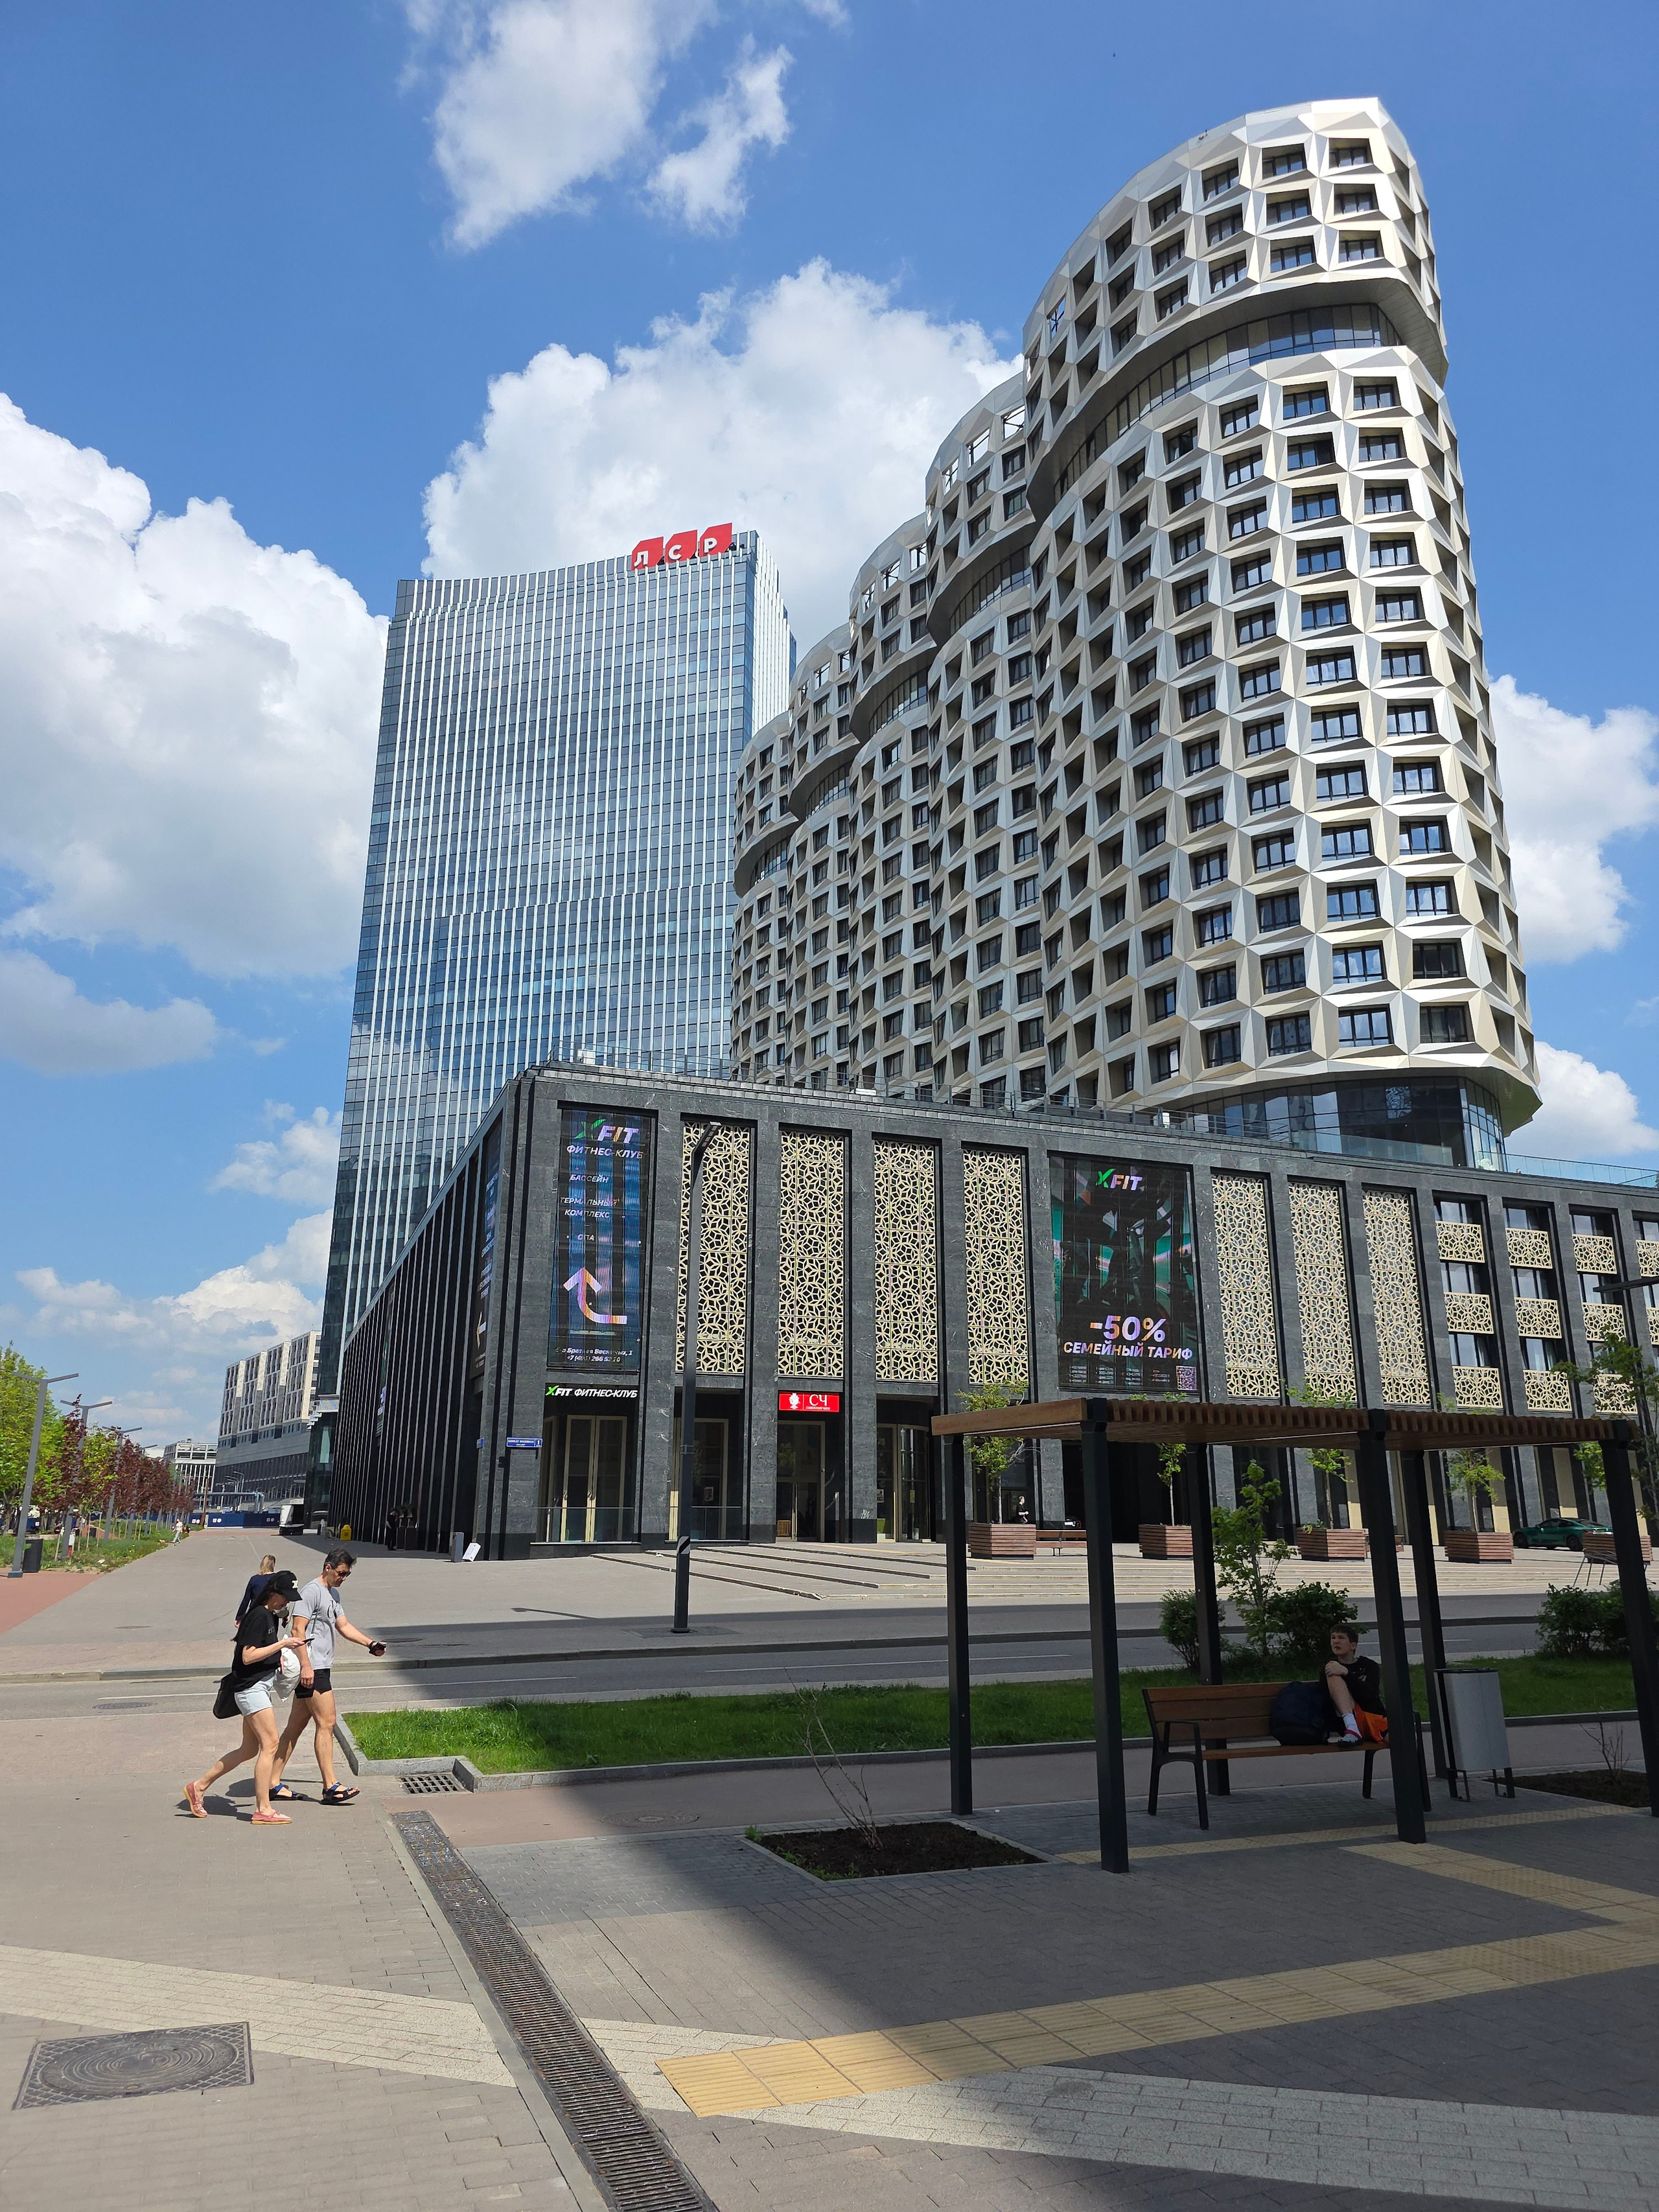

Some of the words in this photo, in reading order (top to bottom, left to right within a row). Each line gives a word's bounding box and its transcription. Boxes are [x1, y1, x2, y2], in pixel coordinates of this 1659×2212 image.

[634, 538, 717, 567] ЛСР
[574, 1119, 639, 1143] XFIT
[566, 1145, 644, 1159] ФИТНЕС-КЛУБ
[570, 1174, 609, 1183] БАССЕЙН
[1096, 1169, 1143, 1190] XFIT
[564, 1209, 610, 1218] КОМПЛЕКС
[1089, 1315, 1166, 1342] -50%
[1063, 1340, 1144, 1356] СЕМЕЙНЫЙ
[1148, 1346, 1193, 1360] ТАРИФ
[545, 1385, 574, 1396] XFIT
[574, 1388, 638, 1398] ФИТНЕС-КЛУБ
[809, 1394, 828, 1406] СЧ
